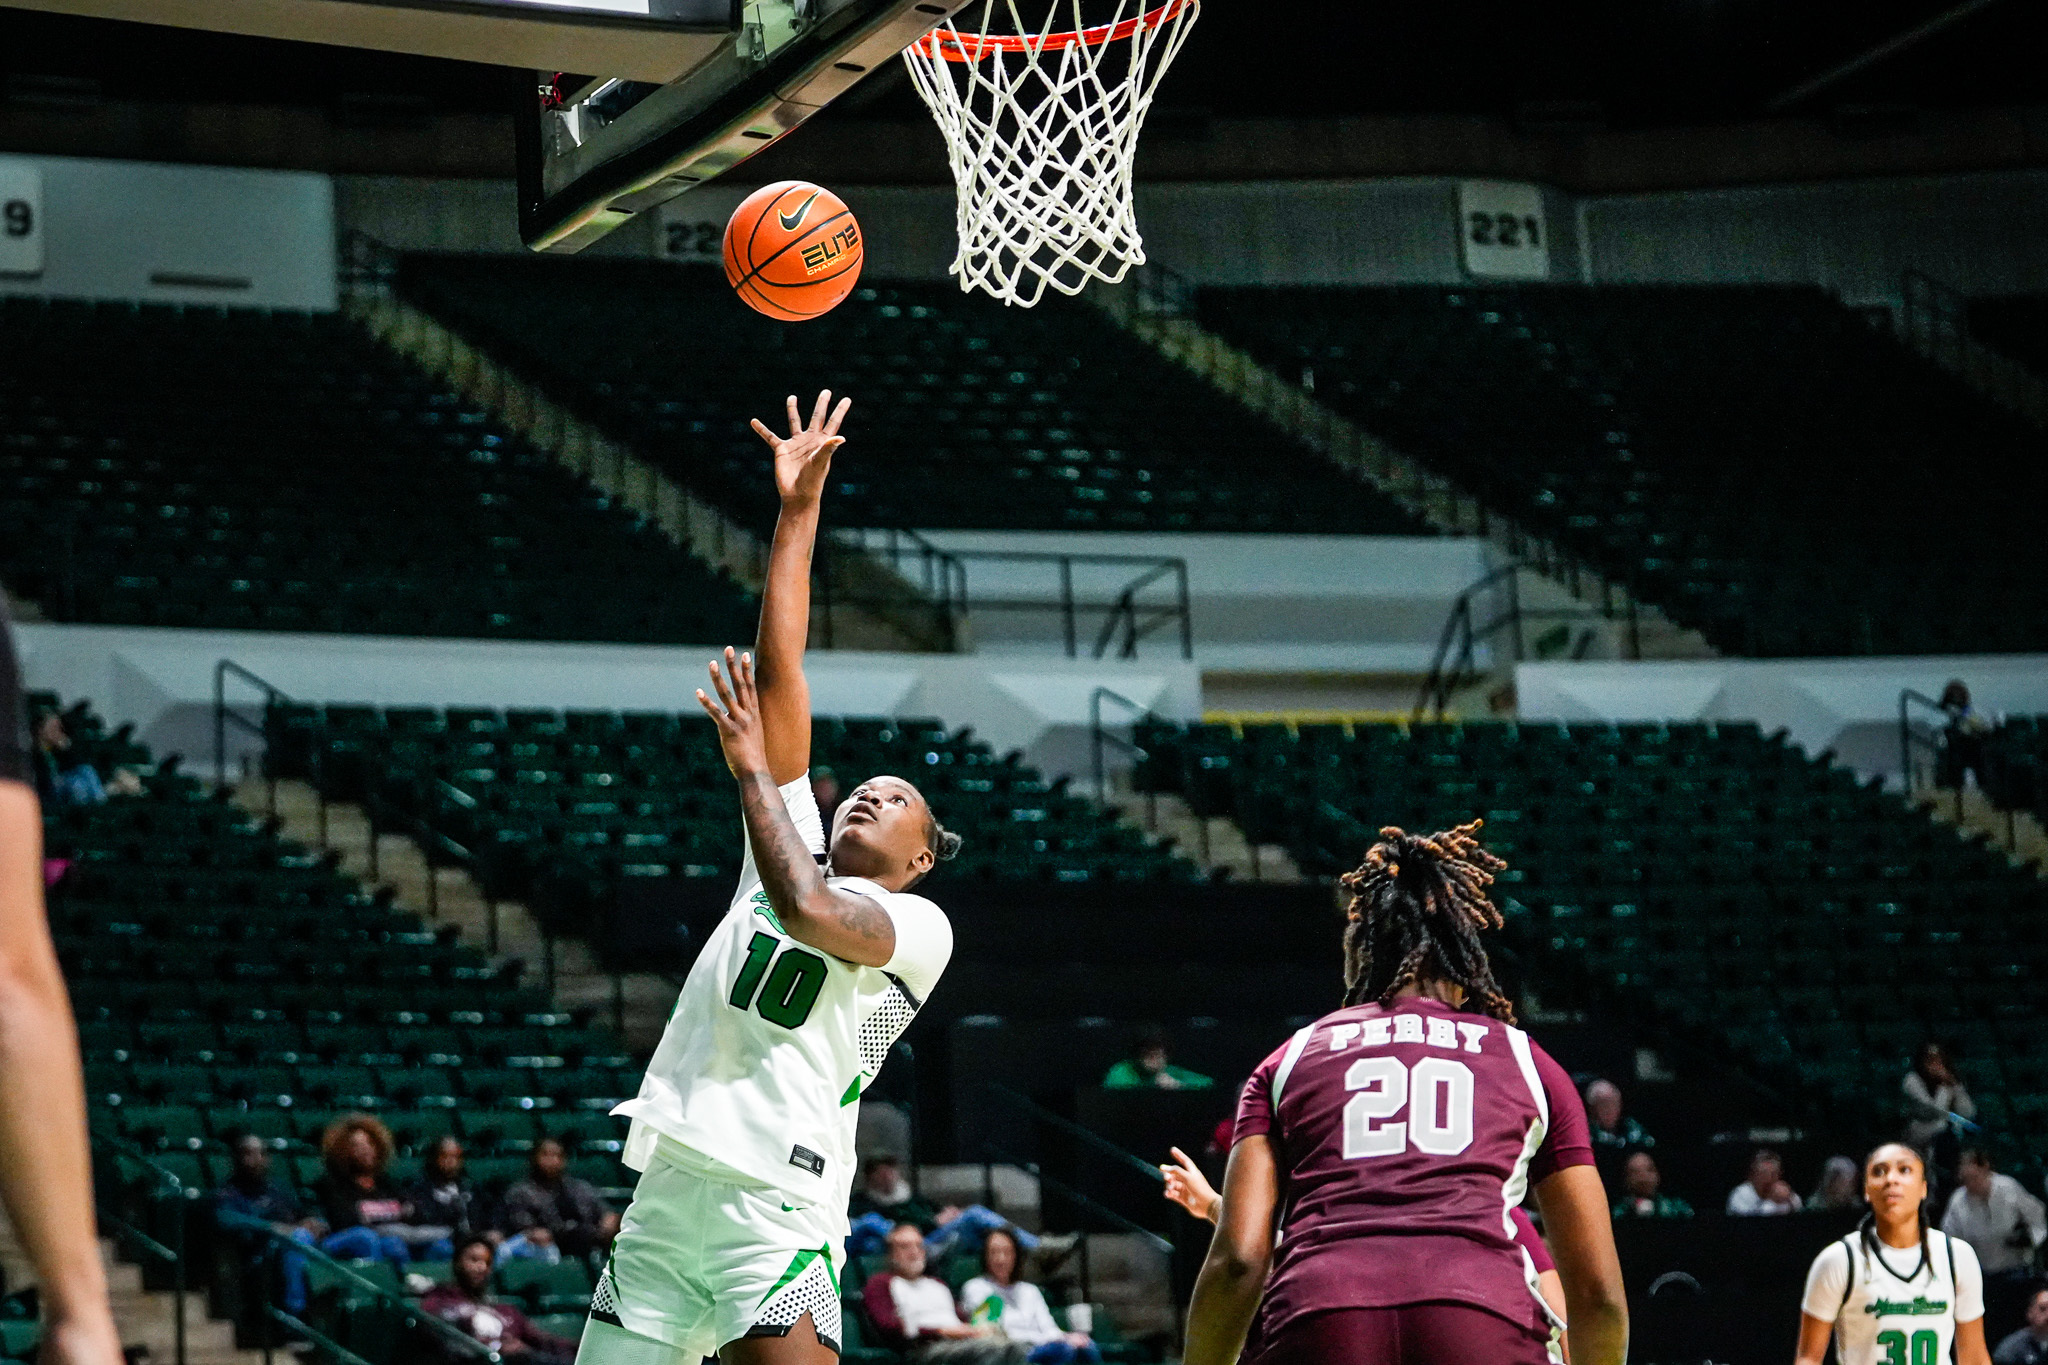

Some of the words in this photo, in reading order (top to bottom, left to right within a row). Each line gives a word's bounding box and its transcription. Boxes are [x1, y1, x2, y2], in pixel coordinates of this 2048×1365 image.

[666, 221, 721, 254] 22
[801, 222, 859, 268] ELITE
[1470, 211, 1539, 248] 221
[729, 930, 828, 1030] 10
[1330, 1013, 1489, 1054] PERRY
[1343, 1056, 1475, 1160] 20
[1876, 1329, 1938, 1365] 30
